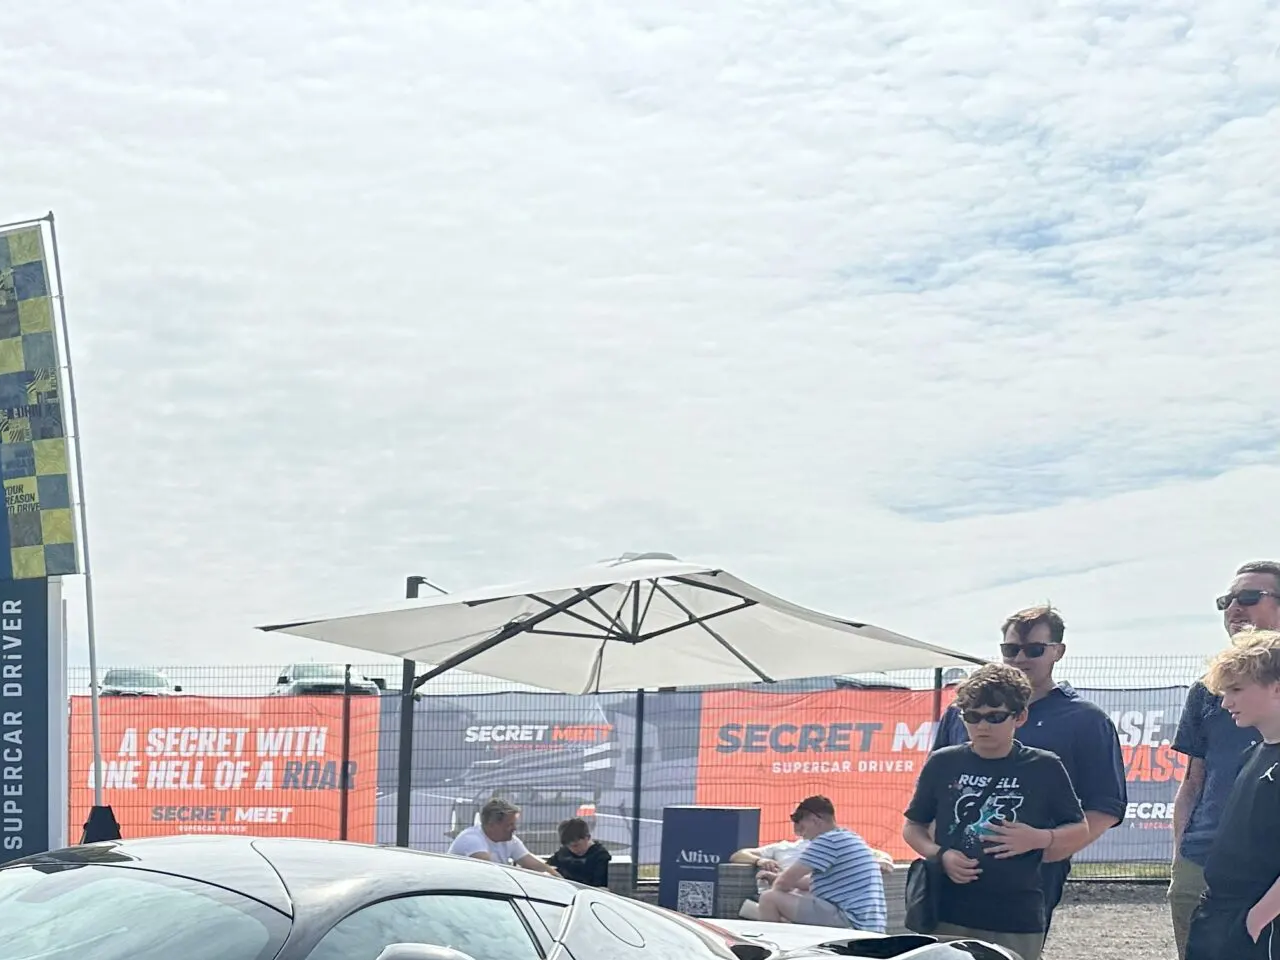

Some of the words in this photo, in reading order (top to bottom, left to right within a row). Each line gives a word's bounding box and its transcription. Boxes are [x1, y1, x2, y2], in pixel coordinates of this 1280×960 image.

[117, 727, 138, 757] A
[144, 726, 250, 758] SECRET
[255, 726, 328, 757] WITH
[464, 724, 549, 743] SECRET
[715, 722, 884, 754] SECRET
[87, 760, 142, 789] ONE
[146, 760, 207, 790] HELL
[213, 760, 251, 791] OF
[254, 760, 274, 791] A
[281, 760, 358, 790] ROAR
[772, 760, 852, 774] SUPERCAR
[858, 760, 914, 773] DRIVER
[1120, 744, 1189, 782] PASS
[3, 710, 23, 850] SUPERCAR
[958, 774, 1020, 789] RUSELL
[151, 805, 232, 822] SECRET
[234, 806, 293, 823] MEET
[1124, 802, 1175, 819] ECRE
